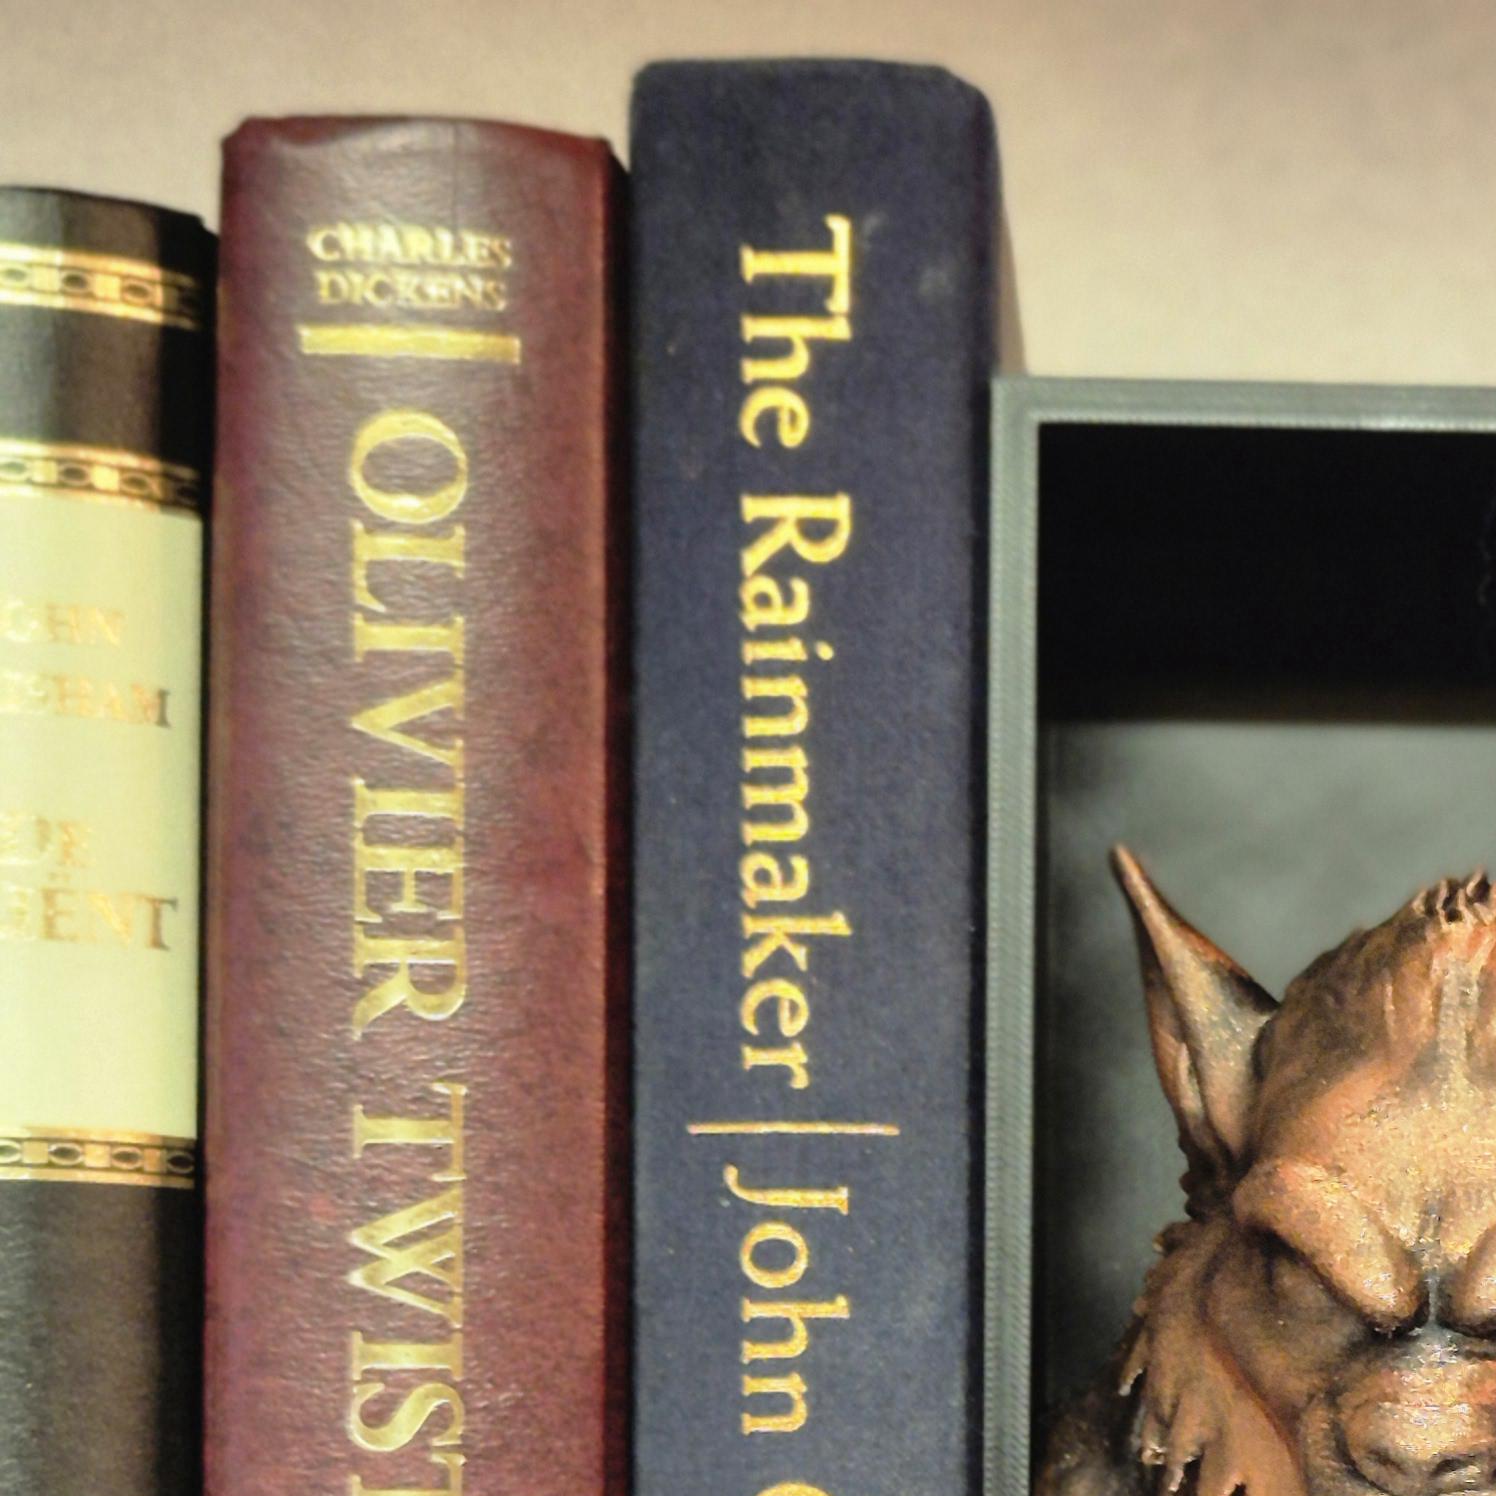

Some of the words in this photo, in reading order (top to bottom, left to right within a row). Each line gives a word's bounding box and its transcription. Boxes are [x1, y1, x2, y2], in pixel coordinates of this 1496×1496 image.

[305, 222, 512, 270] CHARLES
[314, 267, 507, 311] DICKENS
[740, 213, 851, 448] The
[348, 408, 470, 1043] OLIVIER
[740, 493, 852, 1090] Rainmaker
[723, 1164, 851, 1435] John
